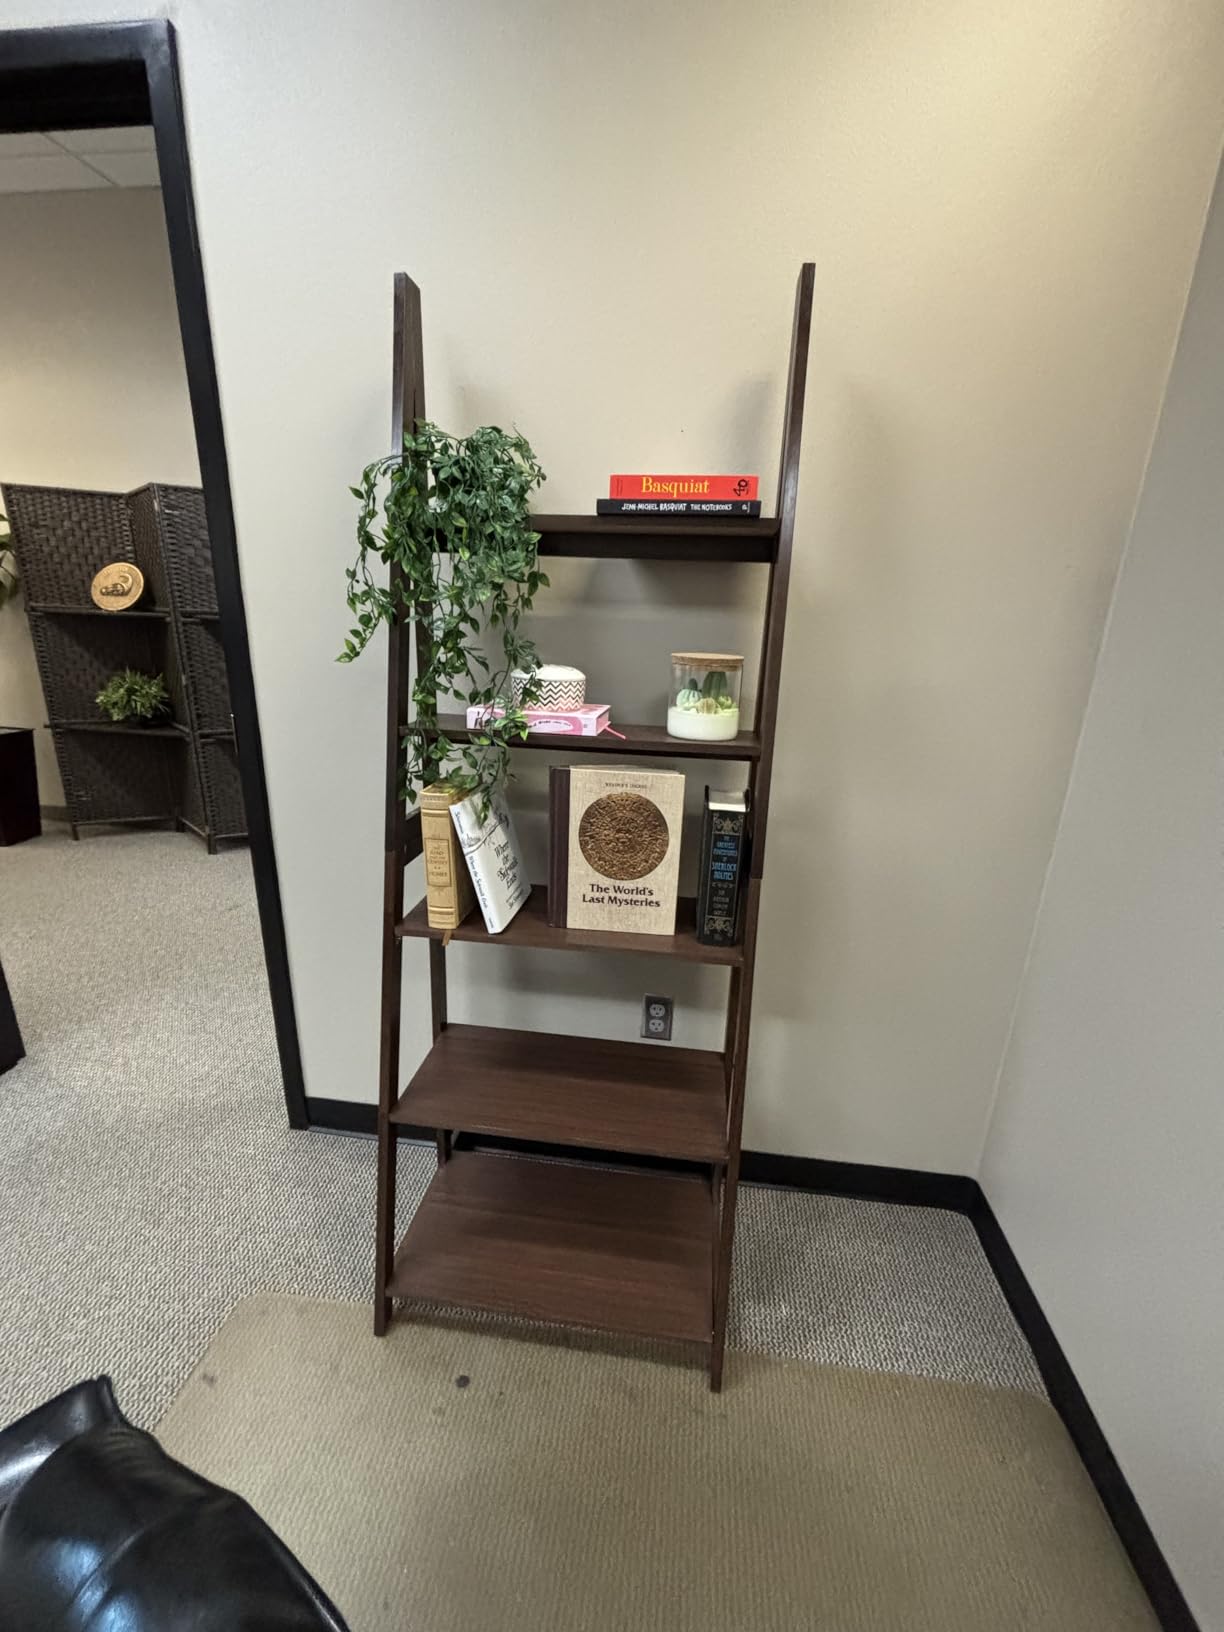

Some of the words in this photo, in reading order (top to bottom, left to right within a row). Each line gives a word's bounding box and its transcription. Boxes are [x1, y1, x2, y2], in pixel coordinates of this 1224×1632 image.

[641, 476, 710, 498] Basquiat
[690, 503, 701, 511] THE
[701, 503, 733, 511] NOTEBOOKS
[589, 883, 611, 894] The
[613, 885, 654, 897] World's
[582, 893, 605, 904] Last
[607, 895, 662, 908] Mysteries
